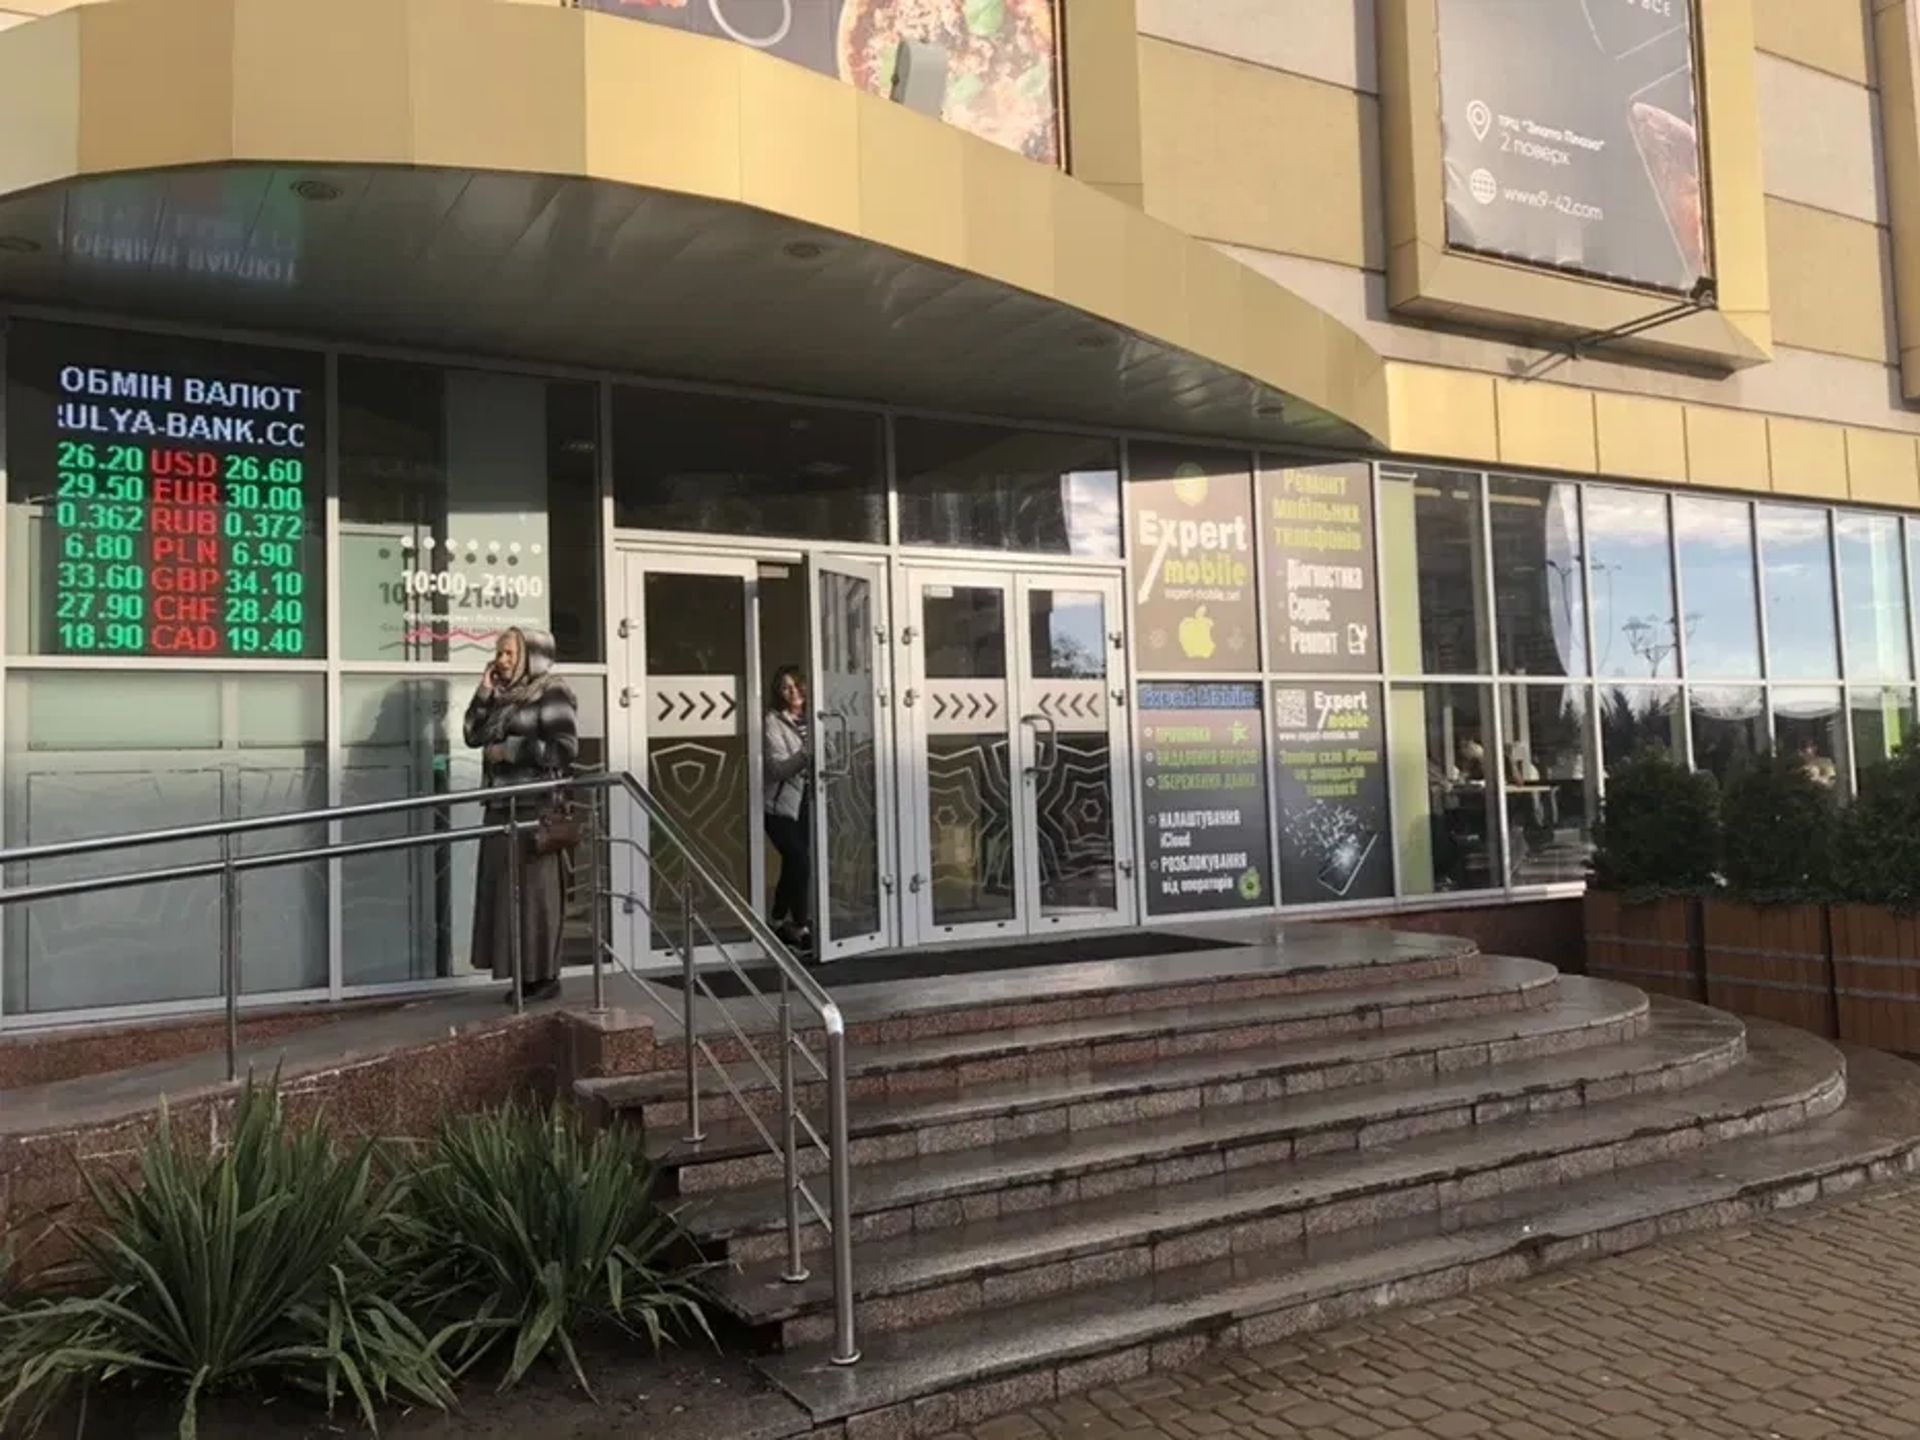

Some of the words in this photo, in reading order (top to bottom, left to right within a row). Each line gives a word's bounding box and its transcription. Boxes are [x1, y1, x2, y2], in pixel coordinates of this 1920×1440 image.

[1499, 131, 1512, 152] 2
[1513, 139, 1571, 166] поверх
[60, 366, 172, 400] ОБМІН
[185, 379, 301, 412] ВАЛЮТ
[58, 443, 143, 472] 26.20
[151, 450, 217, 478] USD
[225, 456, 302, 482] 26.60
[58, 472, 143, 500] 29.50
[153, 479, 218, 505] EUR
[225, 485, 302, 510] 30.00
[58, 502, 143, 531] 0.362
[152, 508, 218, 535] RUB
[224, 513, 302, 539] 0.372
[1138, 510, 1248, 557] Expert
[65, 533, 133, 561] 6.80
[153, 537, 219, 563] PLN
[232, 542, 293, 566] 6.90
[58, 564, 143, 590] 33.60
[152, 567, 220, 592] GBP
[225, 571, 302, 596] 34.10
[1163, 553, 1248, 587] mobile
[58, 594, 143, 619] 27.90
[153, 596, 218, 621] CHF
[225, 600, 302, 624] 28.40
[59, 625, 143, 650] 18.90
[152, 626, 218, 651] CAD
[227, 628, 302, 652] 19.40
[1289, 626, 1339, 654] Ремонт
[1313, 690, 1368, 712] Expert
[1159, 809, 1241, 829] НАЛАШТУВАННЯ
[1159, 831, 1191, 848] iCloud
[1160, 852, 1248, 873] РОЗБЛОКУВАННЯ
